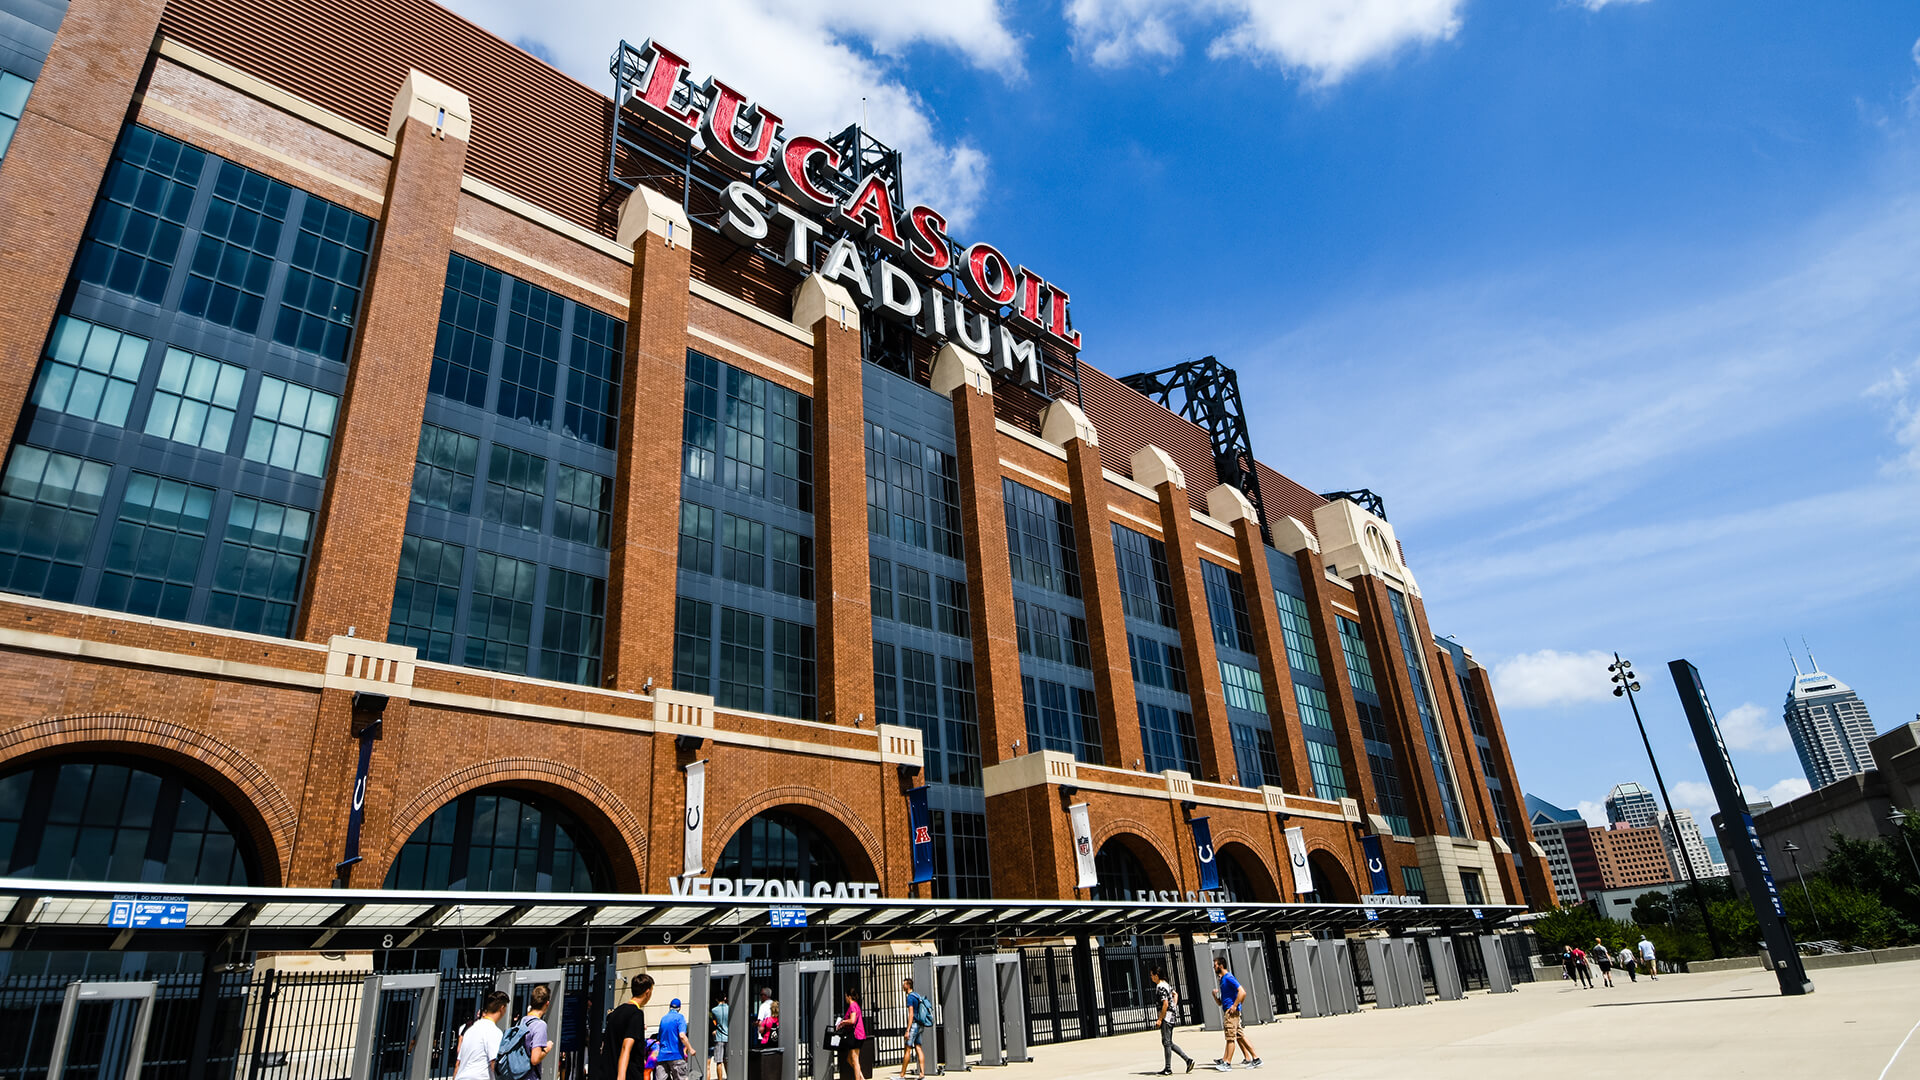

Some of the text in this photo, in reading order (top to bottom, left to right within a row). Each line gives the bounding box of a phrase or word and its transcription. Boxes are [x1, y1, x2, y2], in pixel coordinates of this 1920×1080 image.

[626, 37, 1082, 353] LUCAS OIL
[721, 181, 1039, 385] STADIUM
[669, 876, 879, 898] VERIZON GATE
[1136, 890, 1225, 903] EAST GATE
[382, 934, 393, 948] 8
[663, 931, 670, 944] 9
[862, 929, 871, 940] 10
